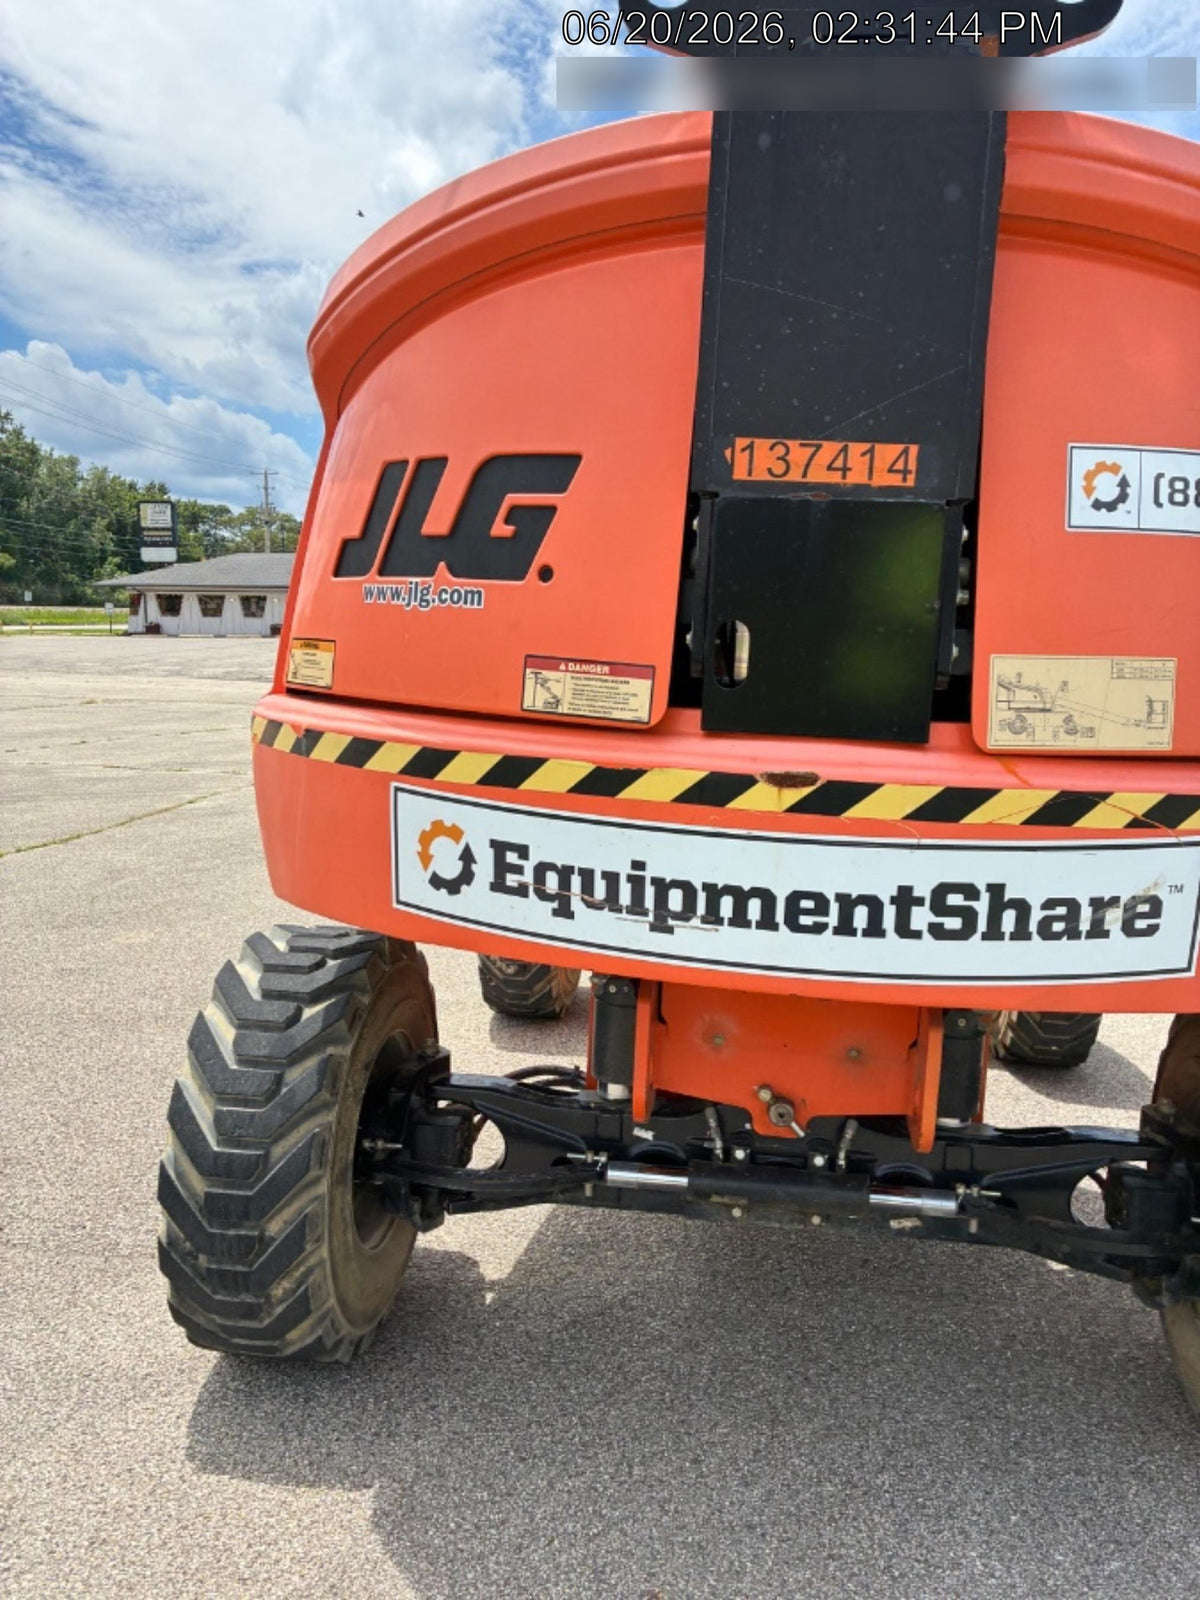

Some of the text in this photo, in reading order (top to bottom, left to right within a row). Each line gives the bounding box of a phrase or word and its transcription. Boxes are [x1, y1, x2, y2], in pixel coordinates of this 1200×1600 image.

[740, 440, 913, 483] 137414
[1153, 472, 1200, 509] (8
[364, 581, 483, 609] www.jlg.com
[568, 662, 610, 674] DANGER
[489, 838, 1164, 942] EquipmentShare
